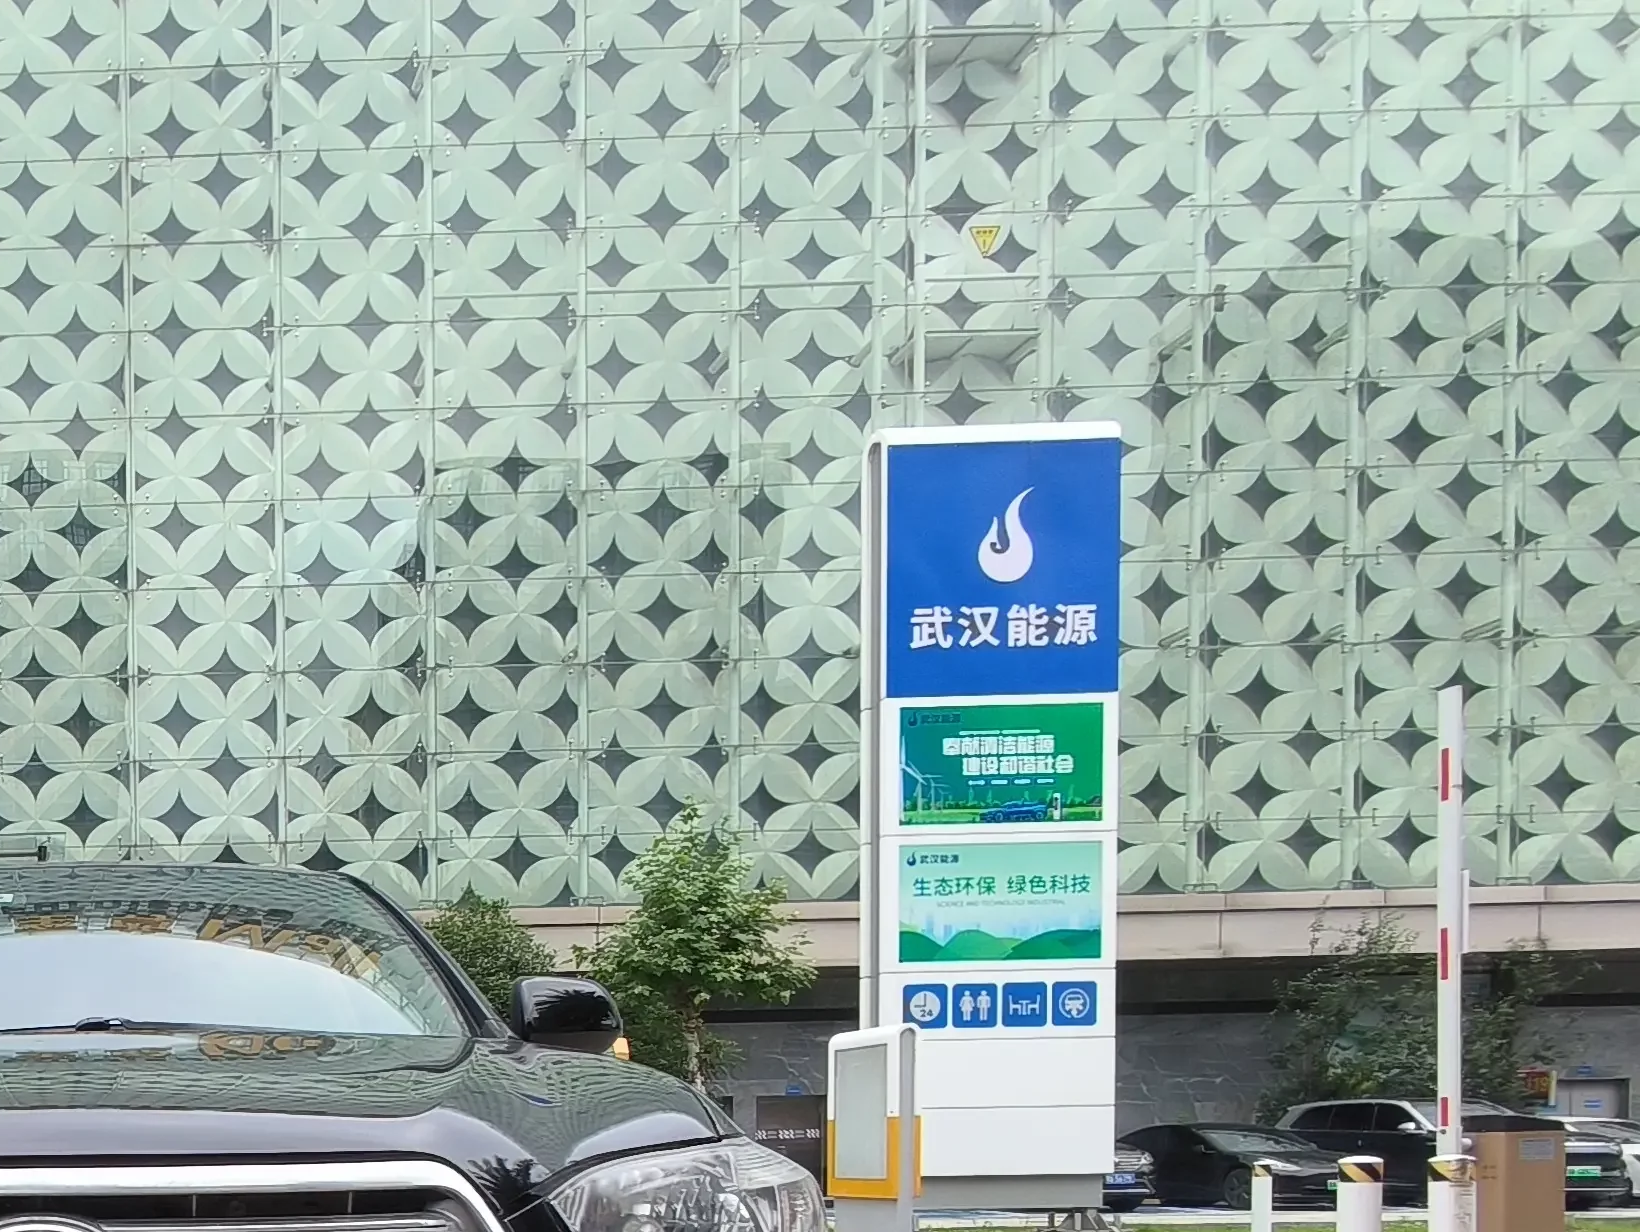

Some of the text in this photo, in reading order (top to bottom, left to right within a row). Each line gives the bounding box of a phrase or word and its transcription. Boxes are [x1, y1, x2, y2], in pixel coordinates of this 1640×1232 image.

[909, 603, 1098, 649] 武汉能源
[919, 853, 960, 865] 武汉能源
[912, 874, 1091, 898] 生态环保 绿色科技
[919, 1008, 934, 1018] 24
